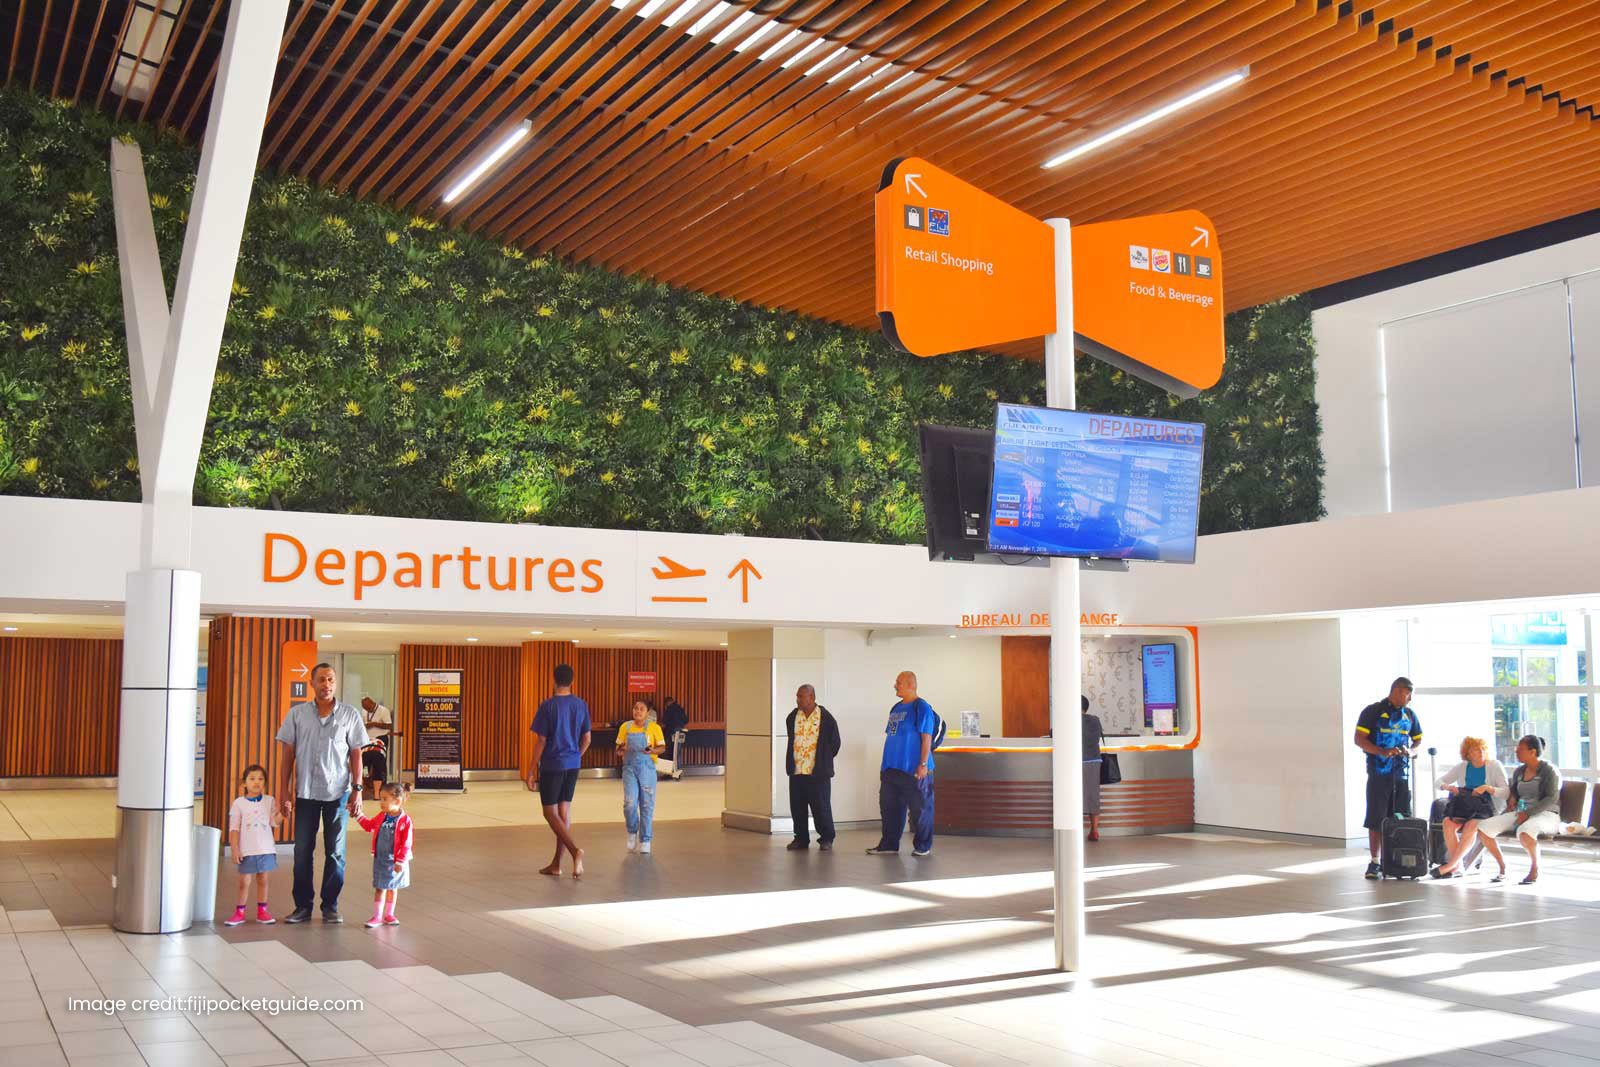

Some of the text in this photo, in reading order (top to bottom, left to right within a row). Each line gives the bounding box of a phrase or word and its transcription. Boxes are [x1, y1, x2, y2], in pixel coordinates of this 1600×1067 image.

[905, 246, 994, 275] Retail Shopping
[1129, 282, 1214, 307] Food & Beverage
[1027, 440, 1049, 448] FLIGHT
[1088, 417, 1195, 445] DEPARTURES
[263, 532, 604, 601] Departures
[961, 612, 1119, 627] BUREAU DE ANGE
